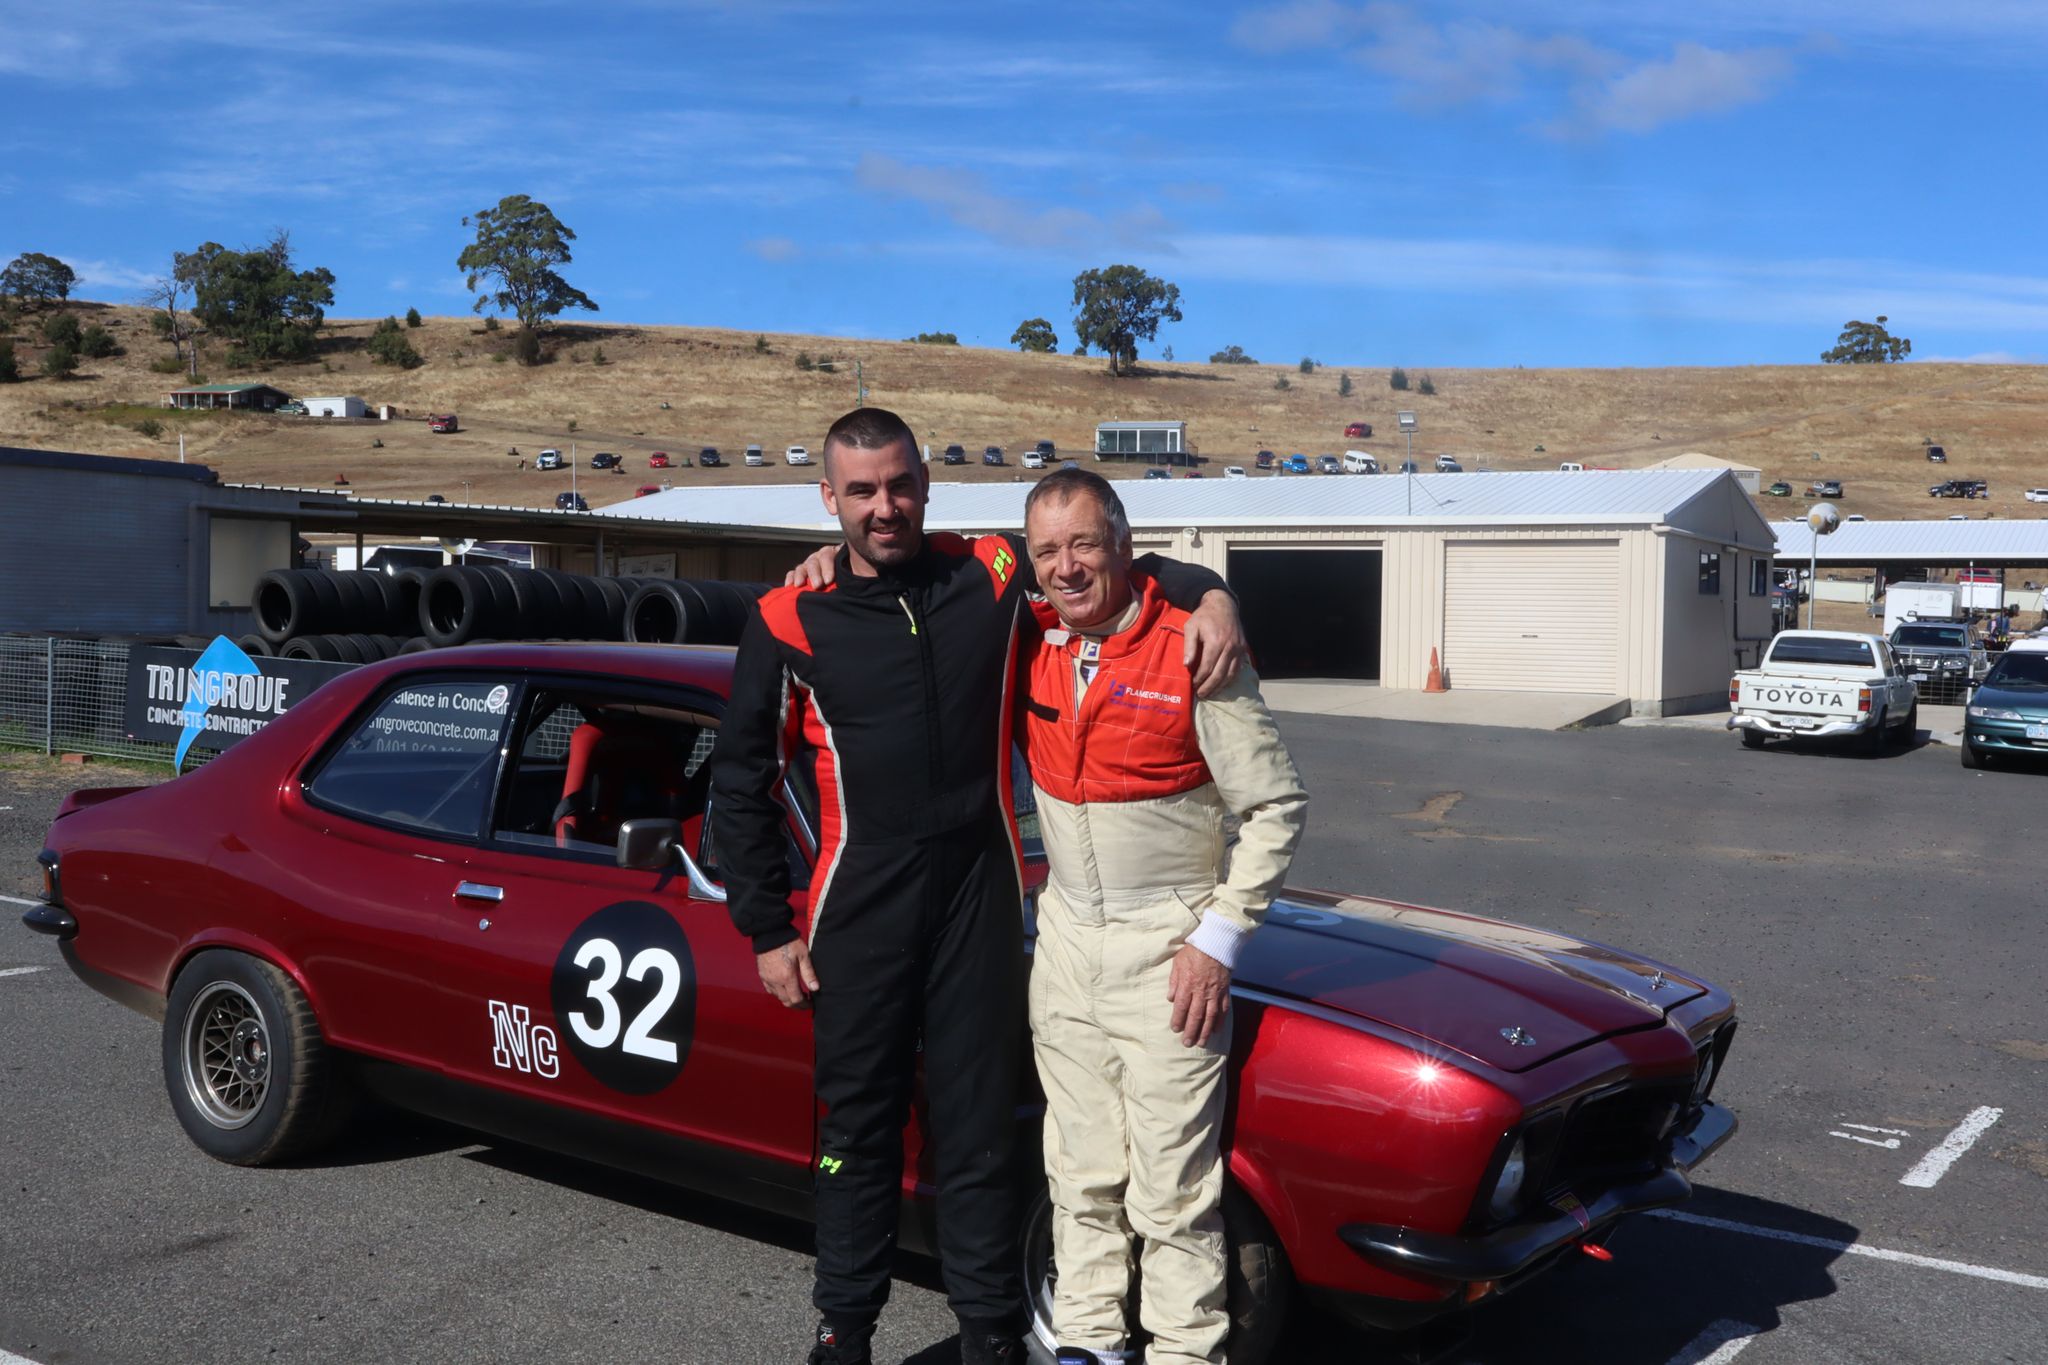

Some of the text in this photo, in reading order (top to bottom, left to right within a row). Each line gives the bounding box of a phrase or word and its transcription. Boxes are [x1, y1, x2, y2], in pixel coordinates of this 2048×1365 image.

[146, 664, 290, 715] TRINGROVE
[392, 690, 435, 708] ellence
[438, 692, 449, 709] in
[1125, 686, 1182, 704] FLAMECRUSHER
[1753, 688, 1843, 707] TOYOTA
[147, 706, 271, 736] CONCRETE CONTRACT
[568, 938, 682, 1063] 32
